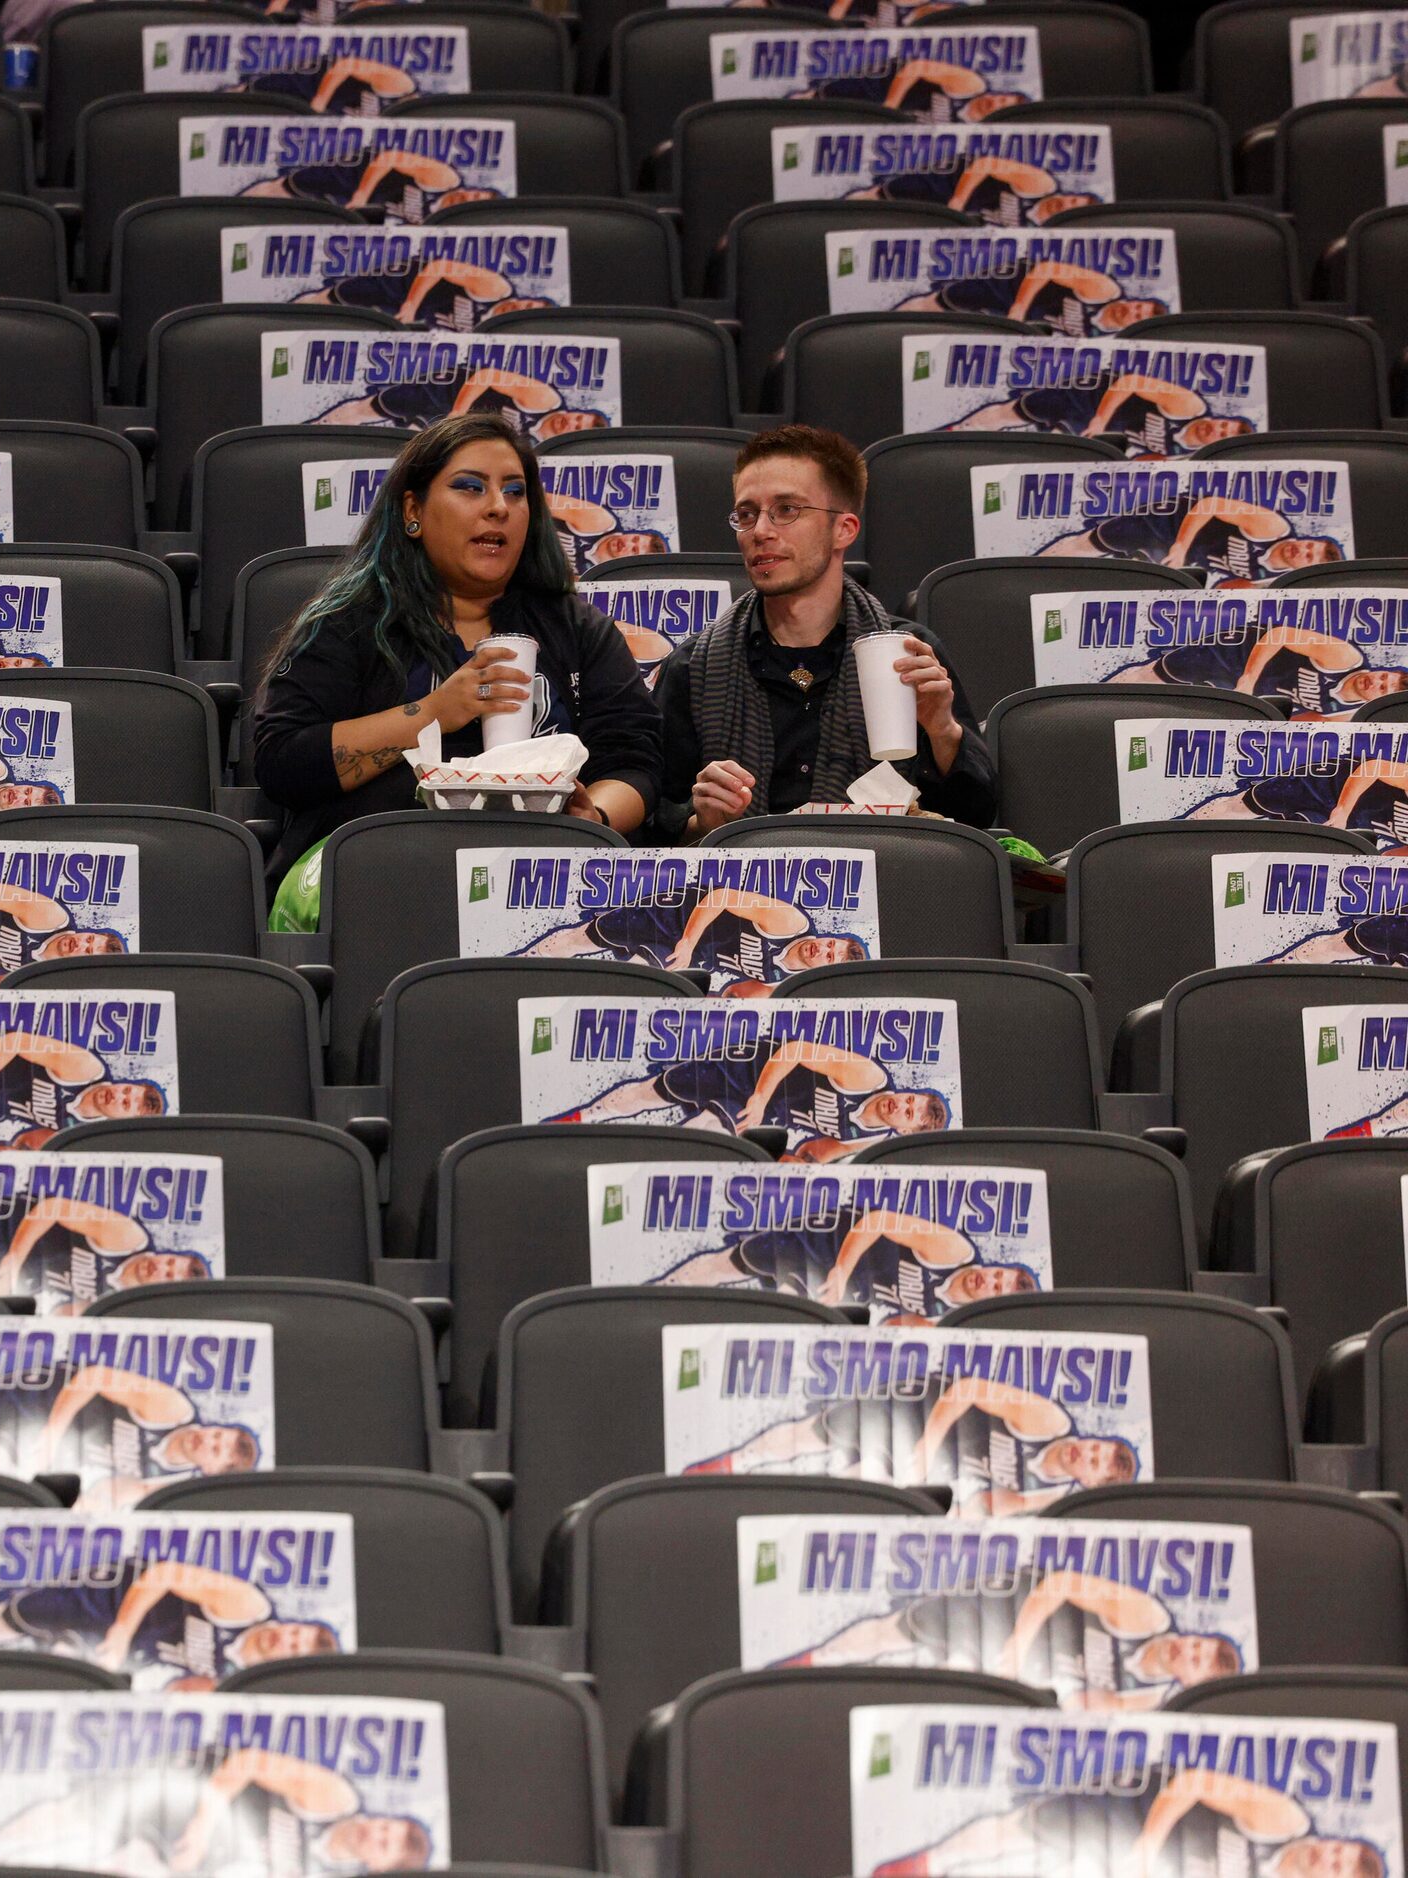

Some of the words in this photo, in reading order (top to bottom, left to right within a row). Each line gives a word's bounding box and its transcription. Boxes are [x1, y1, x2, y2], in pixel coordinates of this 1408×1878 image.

[181, 34, 232, 75] MI
[237, 34, 320, 73] SMO
[329, 36, 457, 75] MAVSI!
[750, 39, 800, 81] MI
[806, 37, 890, 78] SMO
[899, 36, 1027, 74] MAVSI!
[218, 125, 271, 167] MI
[276, 125, 363, 166] SMO
[371, 128, 504, 169] MAVSI!
[812, 134, 864, 177] MI
[870, 133, 957, 174] SMO
[966, 134, 1100, 174] MAVSI!
[262, 234, 316, 278] MI
[321, 234, 411, 277] SMO
[420, 236, 557, 278] MAVSI!
[869, 238, 922, 282] MI
[928, 237, 1017, 280] SMO
[1027, 238, 1164, 279] MAVSI!
[303, 340, 359, 385] MI
[364, 340, 458, 385] SMO
[466, 344, 609, 390] MAVSI!
[944, 344, 1002, 389] MI
[1006, 345, 1101, 390] SMO
[1110, 350, 1254, 397] MAVSI!
[1017, 472, 1075, 520] MI
[1081, 471, 1178, 517] SMO
[1189, 471, 1338, 515] MAVSI!
[1079, 600, 1139, 650] MI
[1146, 599, 1246, 647] SMO
[1165, 730, 1227, 778] MI
[1234, 730, 1339, 778] SMO
[506, 857, 571, 910] MI
[578, 857, 686, 908] SMO
[697, 860, 864, 910] MAVSI!
[1263, 864, 1329, 916] MI
[570, 1008, 638, 1064] MI
[645, 1008, 759, 1062] SMO
[770, 1011, 944, 1064] MAVSI!
[26, 1166, 209, 1224] MAVSI!
[643, 1175, 714, 1233] MI
[721, 1175, 840, 1232] SMO
[852, 1179, 1034, 1237] MAVSI!
[66, 1333, 258, 1396] MAVSI!
[720, 1338, 796, 1400] MI
[803, 1338, 929, 1401] SMO
[941, 1344, 1133, 1408] MAVSI!
[136, 1527, 336, 1591] MAVSI!
[799, 1530, 878, 1596] MI
[887, 1530, 1019, 1596] SMO
[1032, 1536, 1235, 1603] MAVSI!
[65, 1708, 203, 1775] SMO
[216, 1713, 428, 1780] MAVSI!
[915, 1722, 999, 1792] MI
[1008, 1723, 1149, 1795] SMO
[1163, 1732, 1379, 1806] MAVSI!
